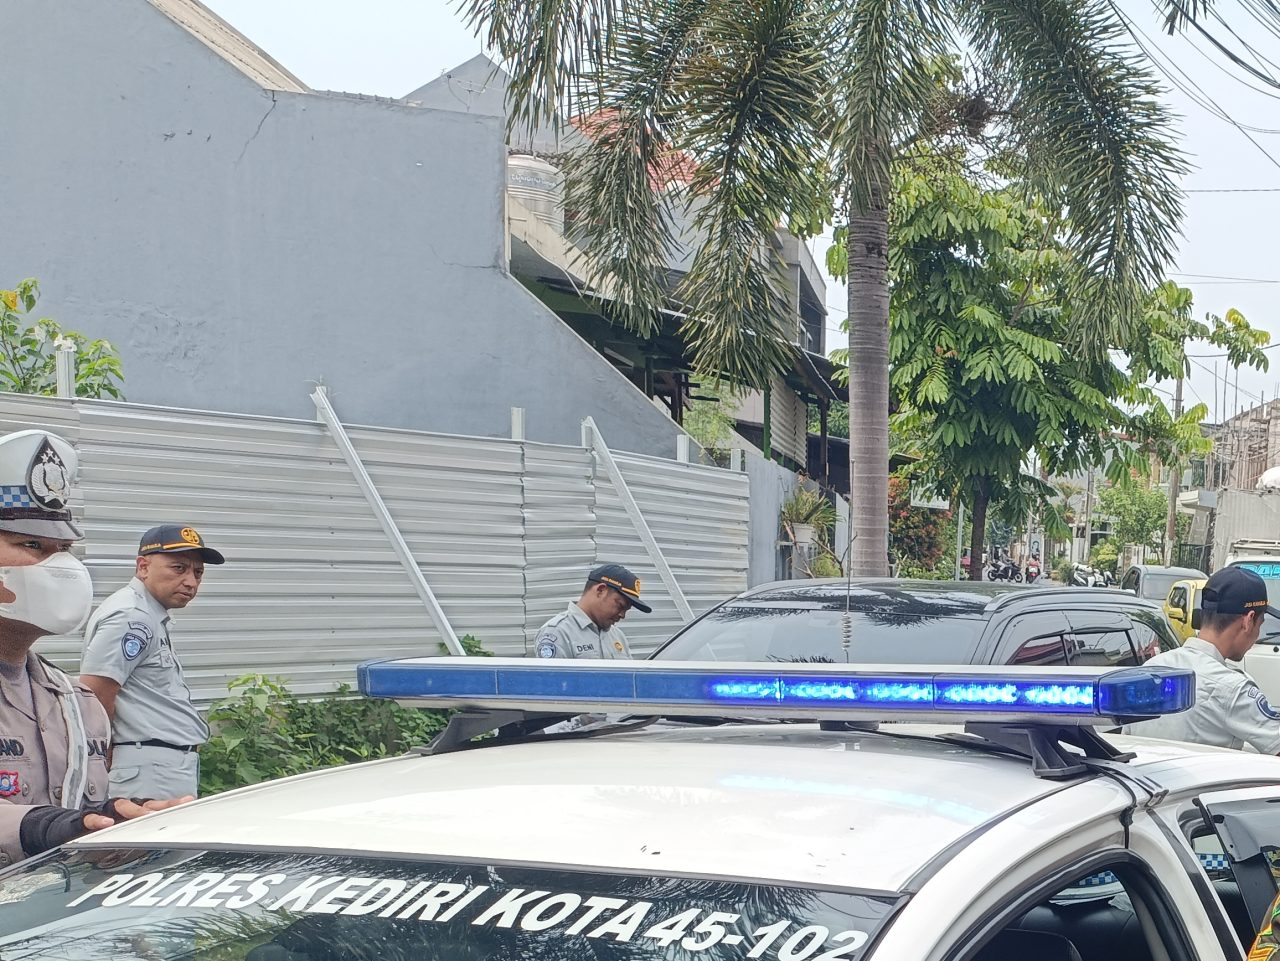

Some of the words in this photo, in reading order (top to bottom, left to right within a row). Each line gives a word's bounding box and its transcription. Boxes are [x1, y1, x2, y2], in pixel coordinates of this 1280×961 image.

[576, 643, 595, 653] DENI
[66, 872, 287, 910] POLRES
[267, 875, 490, 923] KEDIRI
[472, 889, 653, 943] KOTA
